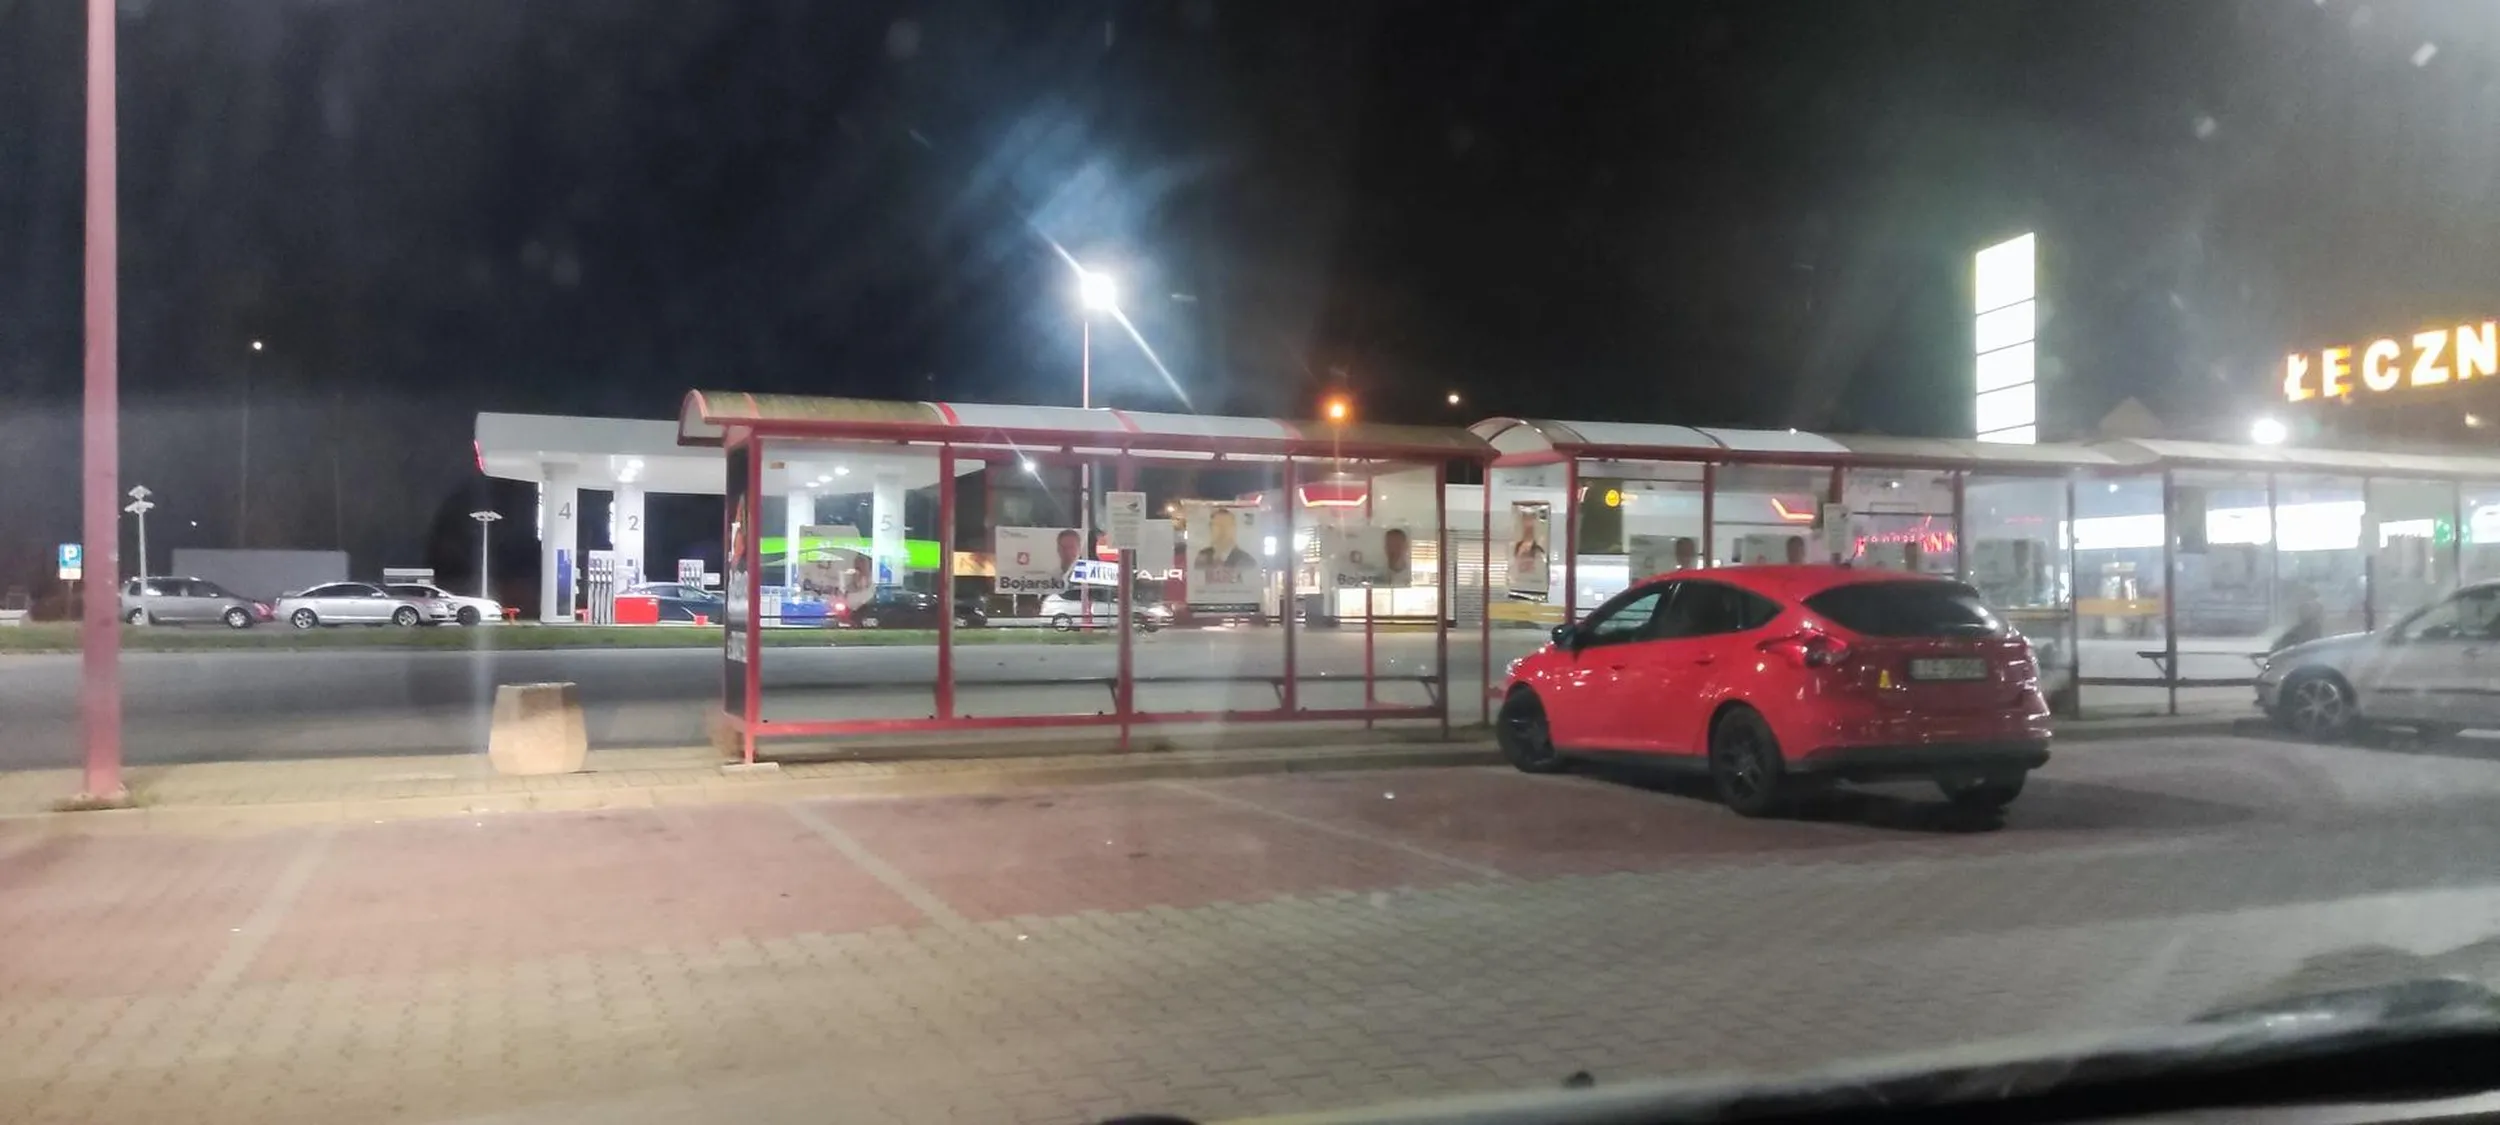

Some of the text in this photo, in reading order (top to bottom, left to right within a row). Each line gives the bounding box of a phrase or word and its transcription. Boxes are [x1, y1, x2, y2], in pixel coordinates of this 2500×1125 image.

[558, 502, 571, 520] 4
[628, 515, 639, 531] 2
[881, 514, 893, 532] 5
[1000, 575, 1065, 591] Bojarski
